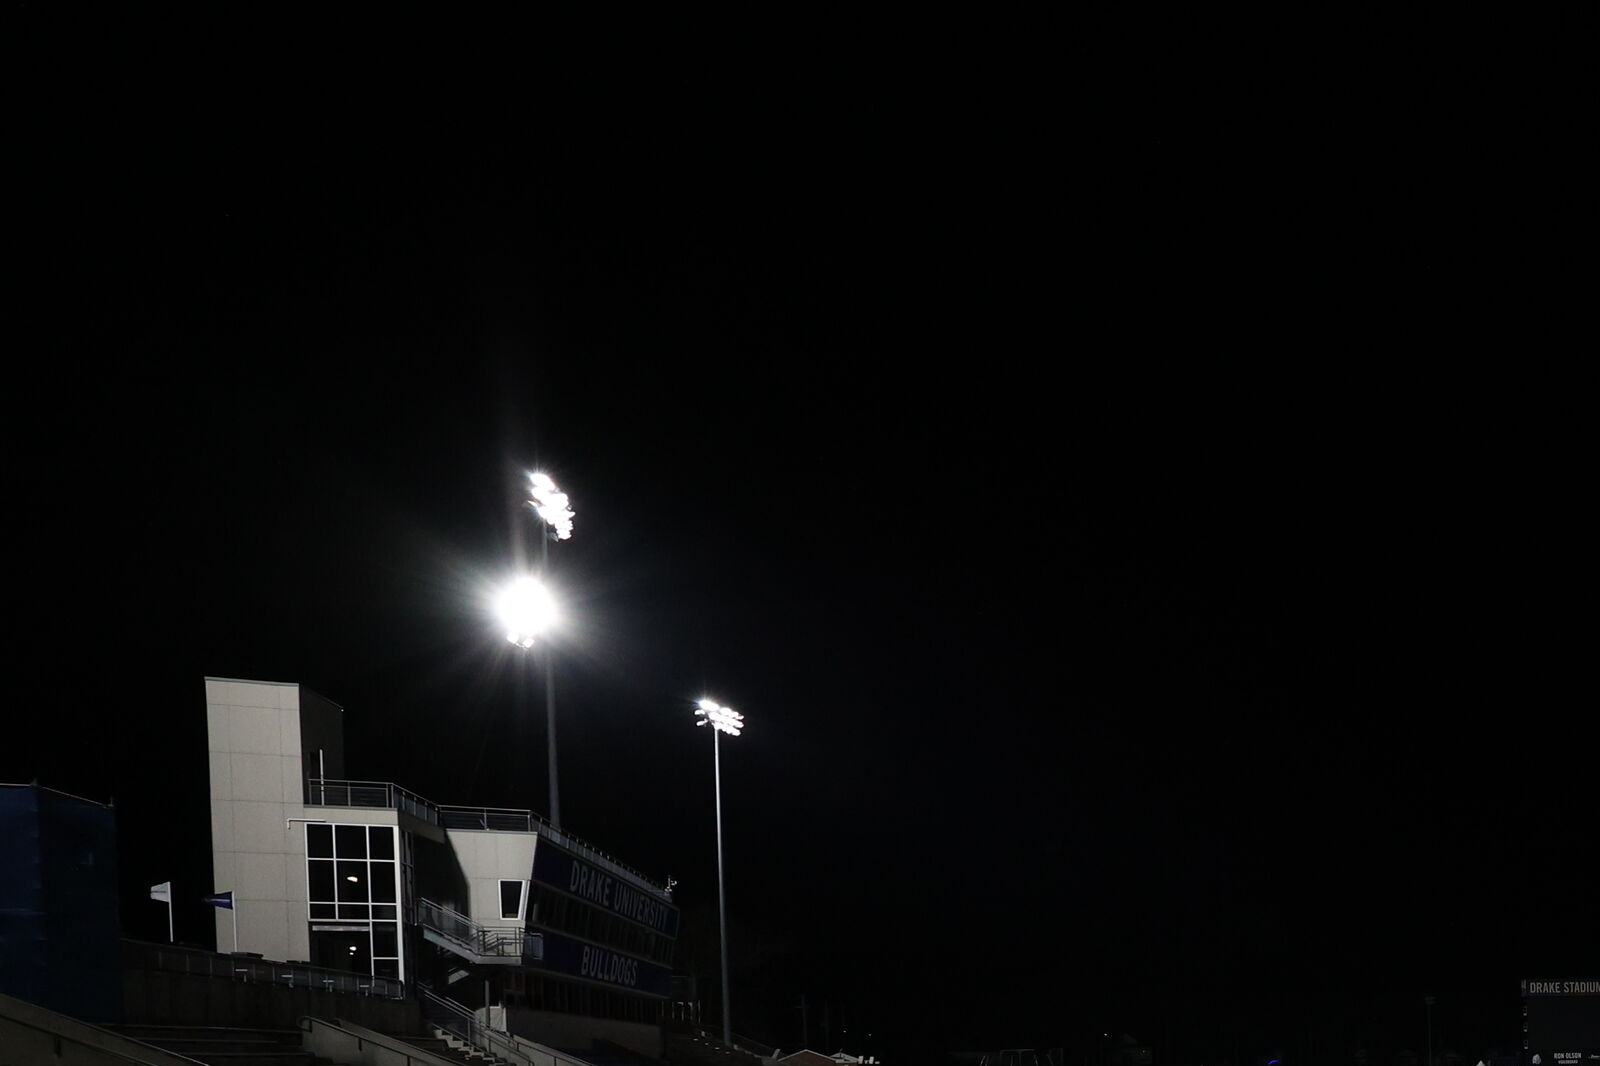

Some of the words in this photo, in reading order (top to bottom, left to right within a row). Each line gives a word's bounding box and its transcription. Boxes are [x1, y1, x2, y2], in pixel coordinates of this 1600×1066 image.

[569, 859, 612, 908] DRAKE
[613, 881, 669, 932] UNIVERSITY
[580, 944, 638, 987] BULLDOGS
[1529, 981, 1561, 994] DRAKE
